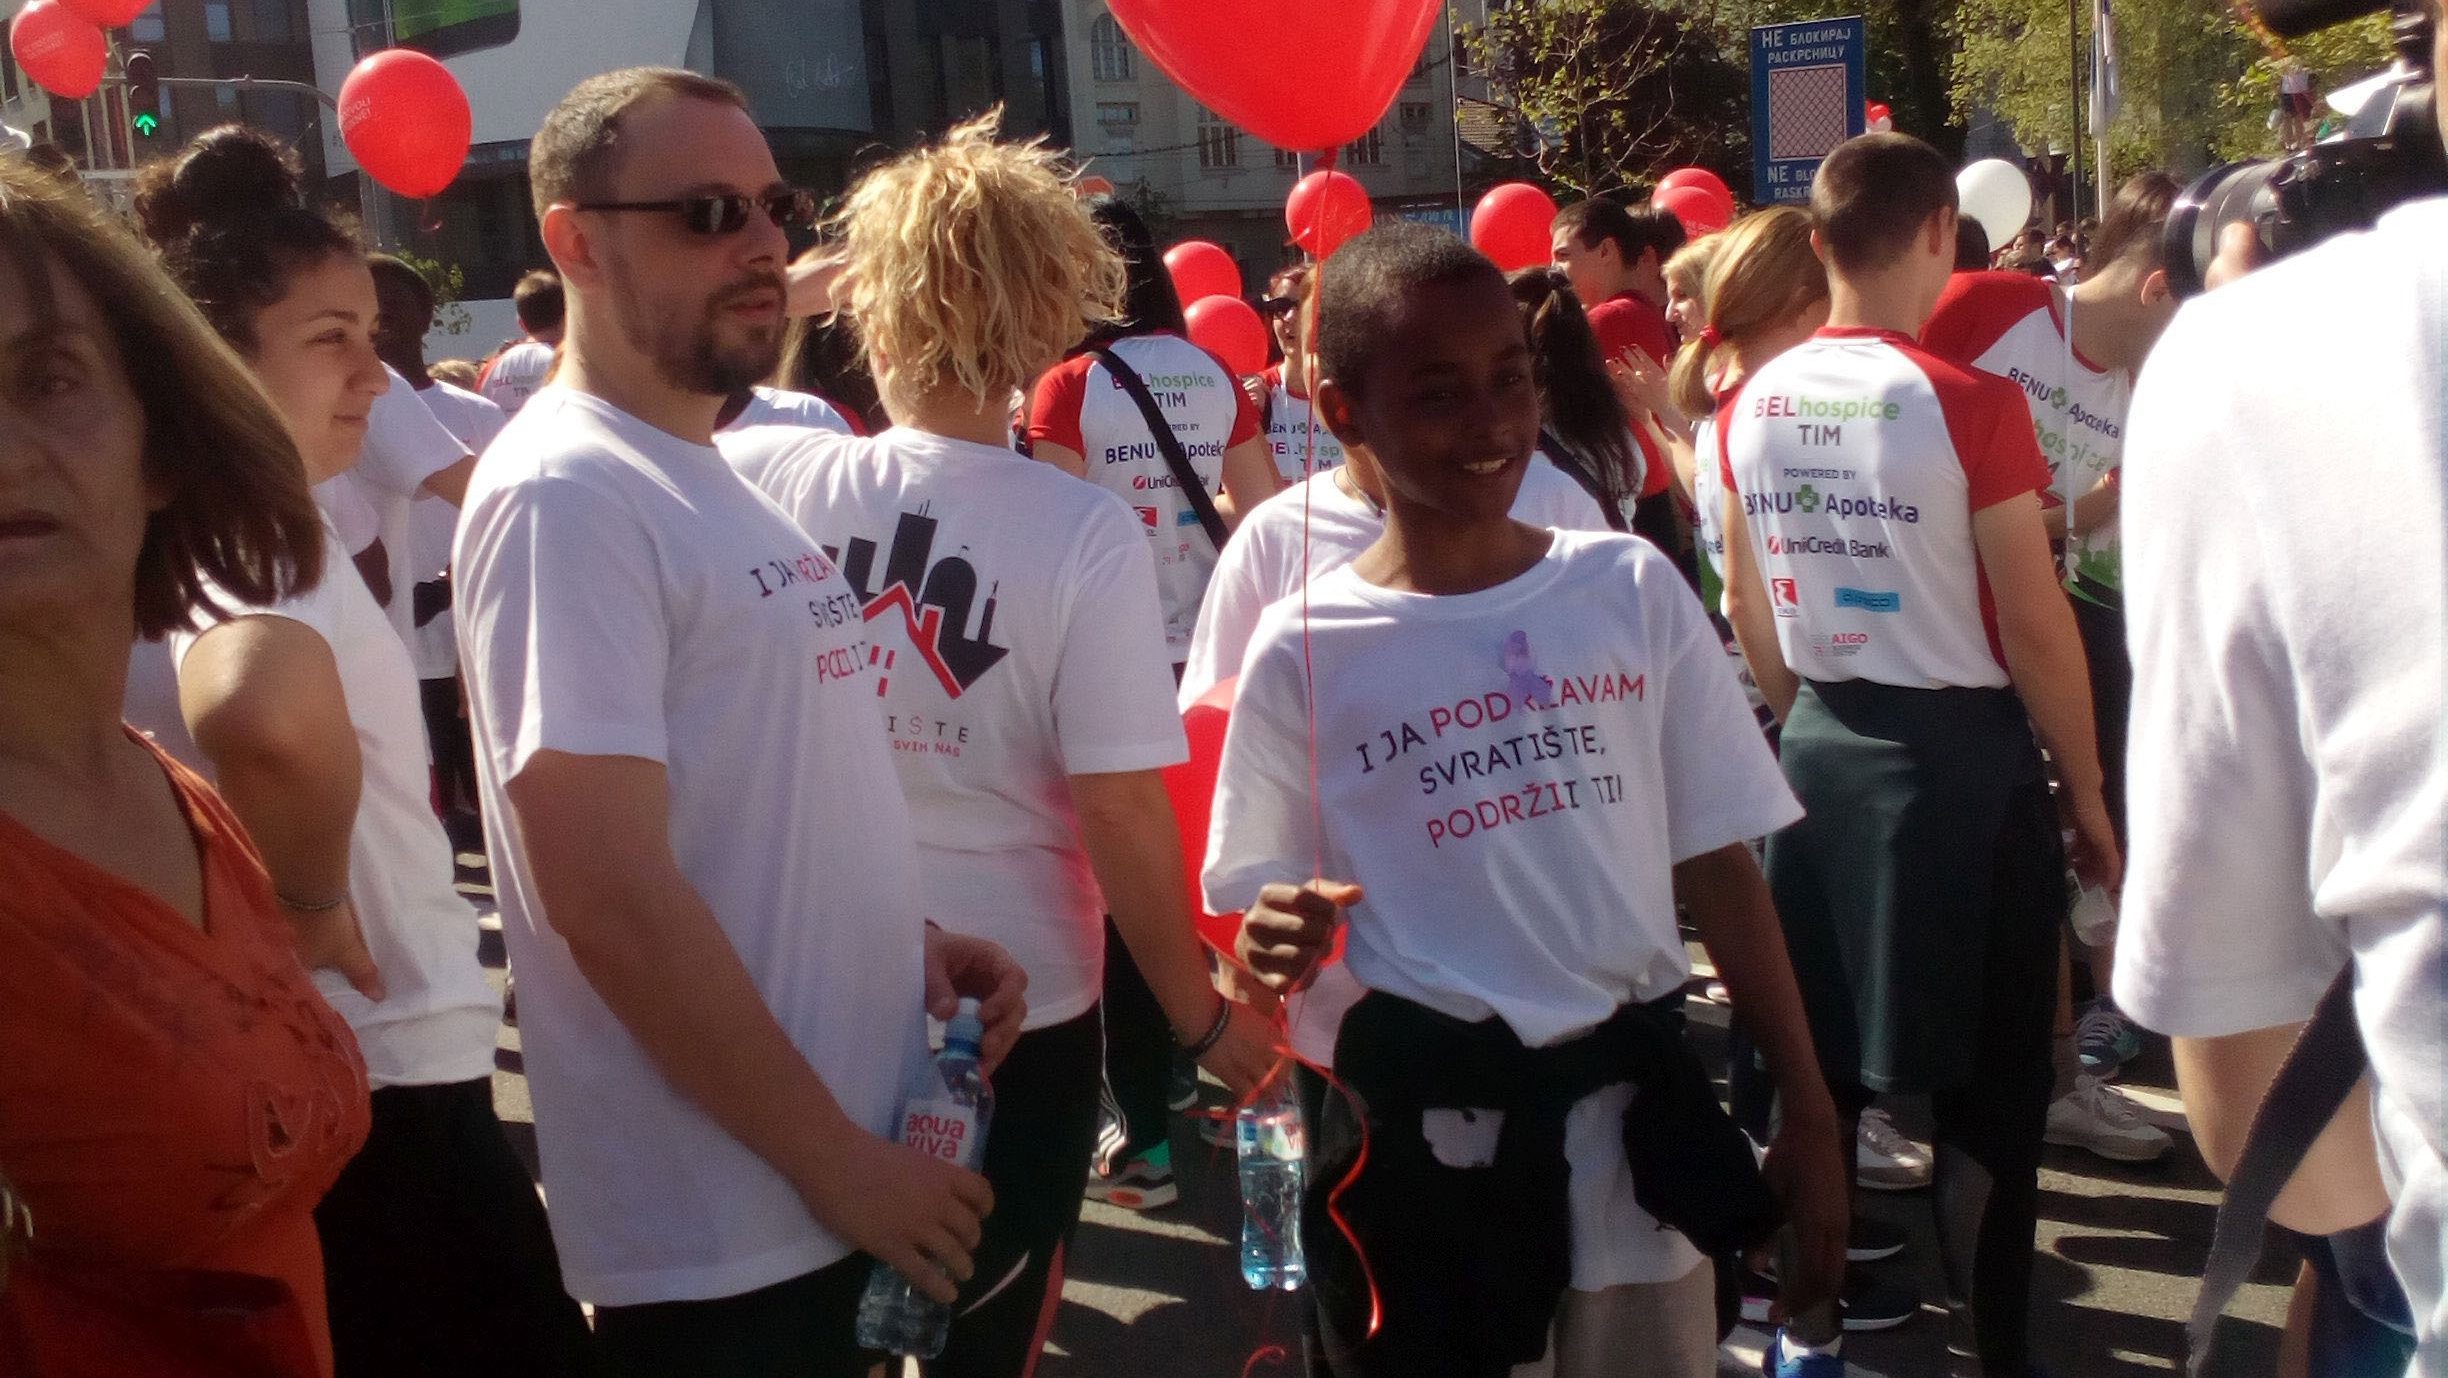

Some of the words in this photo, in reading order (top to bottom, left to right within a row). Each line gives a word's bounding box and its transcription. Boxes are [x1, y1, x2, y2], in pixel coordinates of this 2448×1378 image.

[1762, 29, 1783, 48] НЕ
[1790, 28, 1851, 46] БЛОКИРАЈ
[1768, 45, 1845, 64] РАСКРСНИЦУ
[1768, 165, 1789, 183] NE
[1795, 169, 1816, 182] BLO
[1153, 392, 1187, 408] TIM
[1797, 424, 1842, 447] TIM
[1105, 442, 1155, 464] BENU
[1783, 468, 1839, 479] POWERED
[1843, 470, 1857, 480] BY
[1825, 493, 1920, 524] Apoteka
[1850, 540, 1890, 559] Bank
[750, 567, 773, 598] I
[935, 742, 960, 758] NAS
[1356, 742, 1374, 774] I
[1380, 722, 1428, 763] JA
[1419, 724, 1606, 795] SVRATIŠTE,
[1427, 782, 1566, 849] PODRŽI
